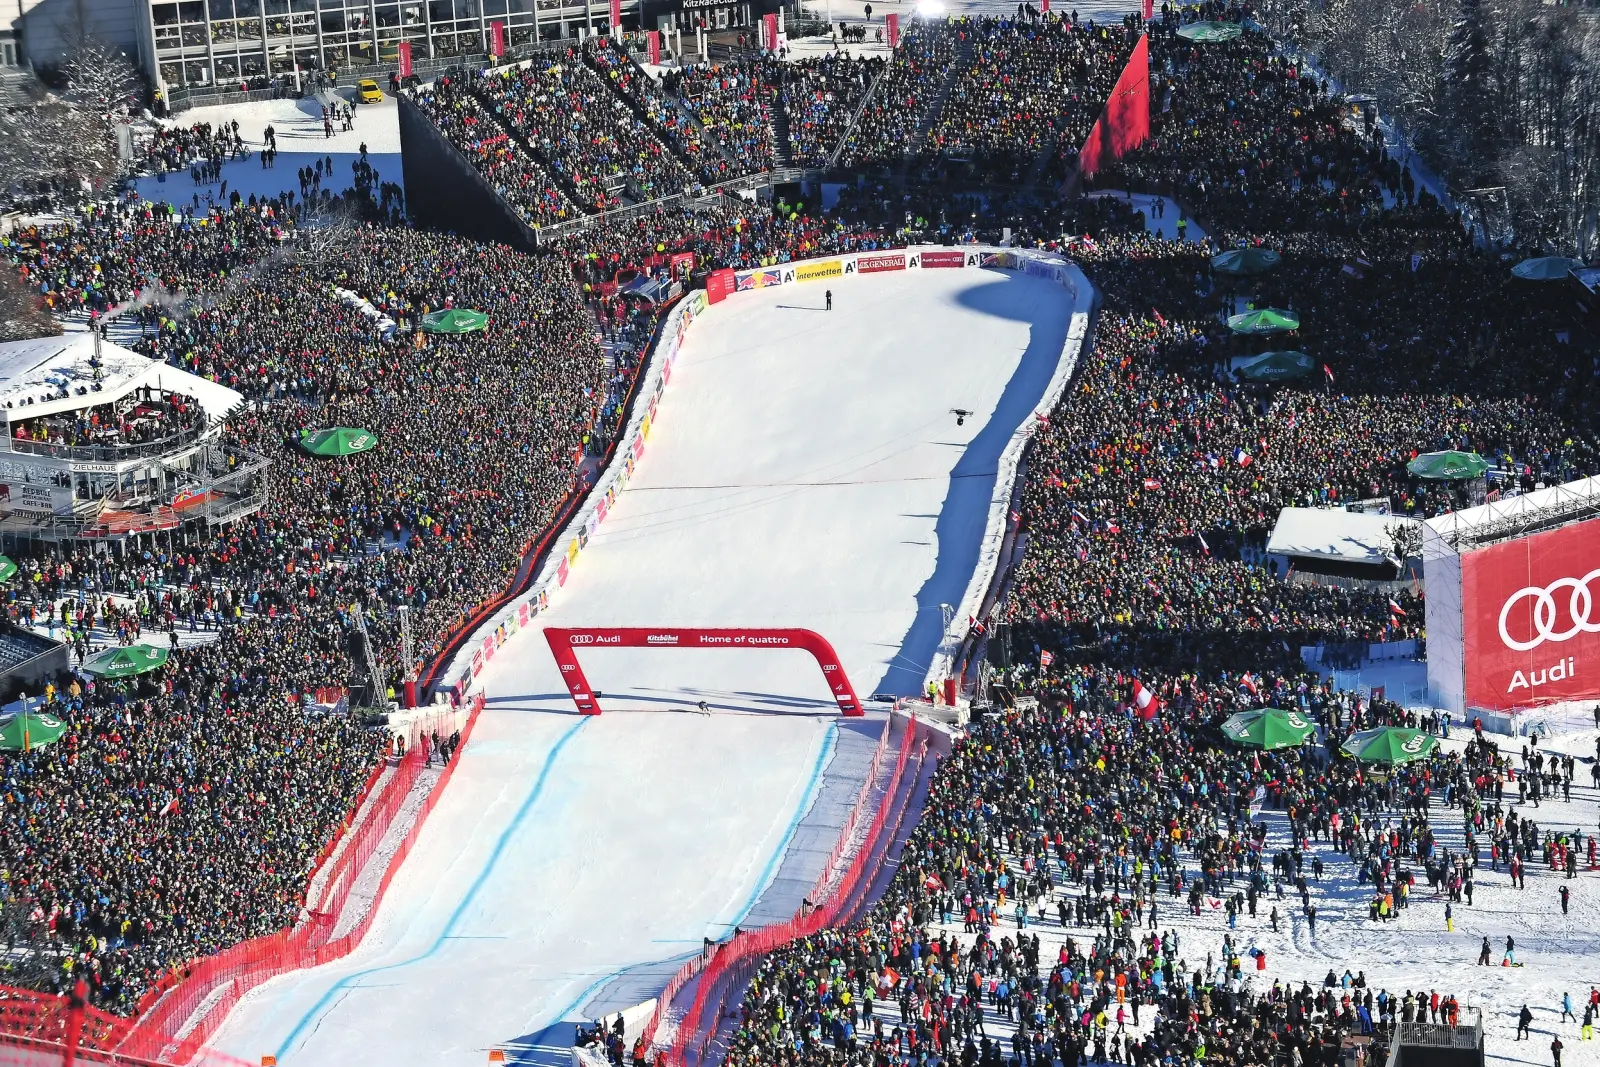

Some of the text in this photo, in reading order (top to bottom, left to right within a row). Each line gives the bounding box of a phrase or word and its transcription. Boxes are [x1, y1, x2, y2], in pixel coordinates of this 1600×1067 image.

[869, 258, 905, 268] GENERALI
[796, 268, 842, 281] interwetten
[72, 464, 117, 472] ZIELHAUS
[596, 635, 621, 643] Audi
[700, 635, 789, 644] Home of quattro
[1507, 656, 1575, 693] Audi
